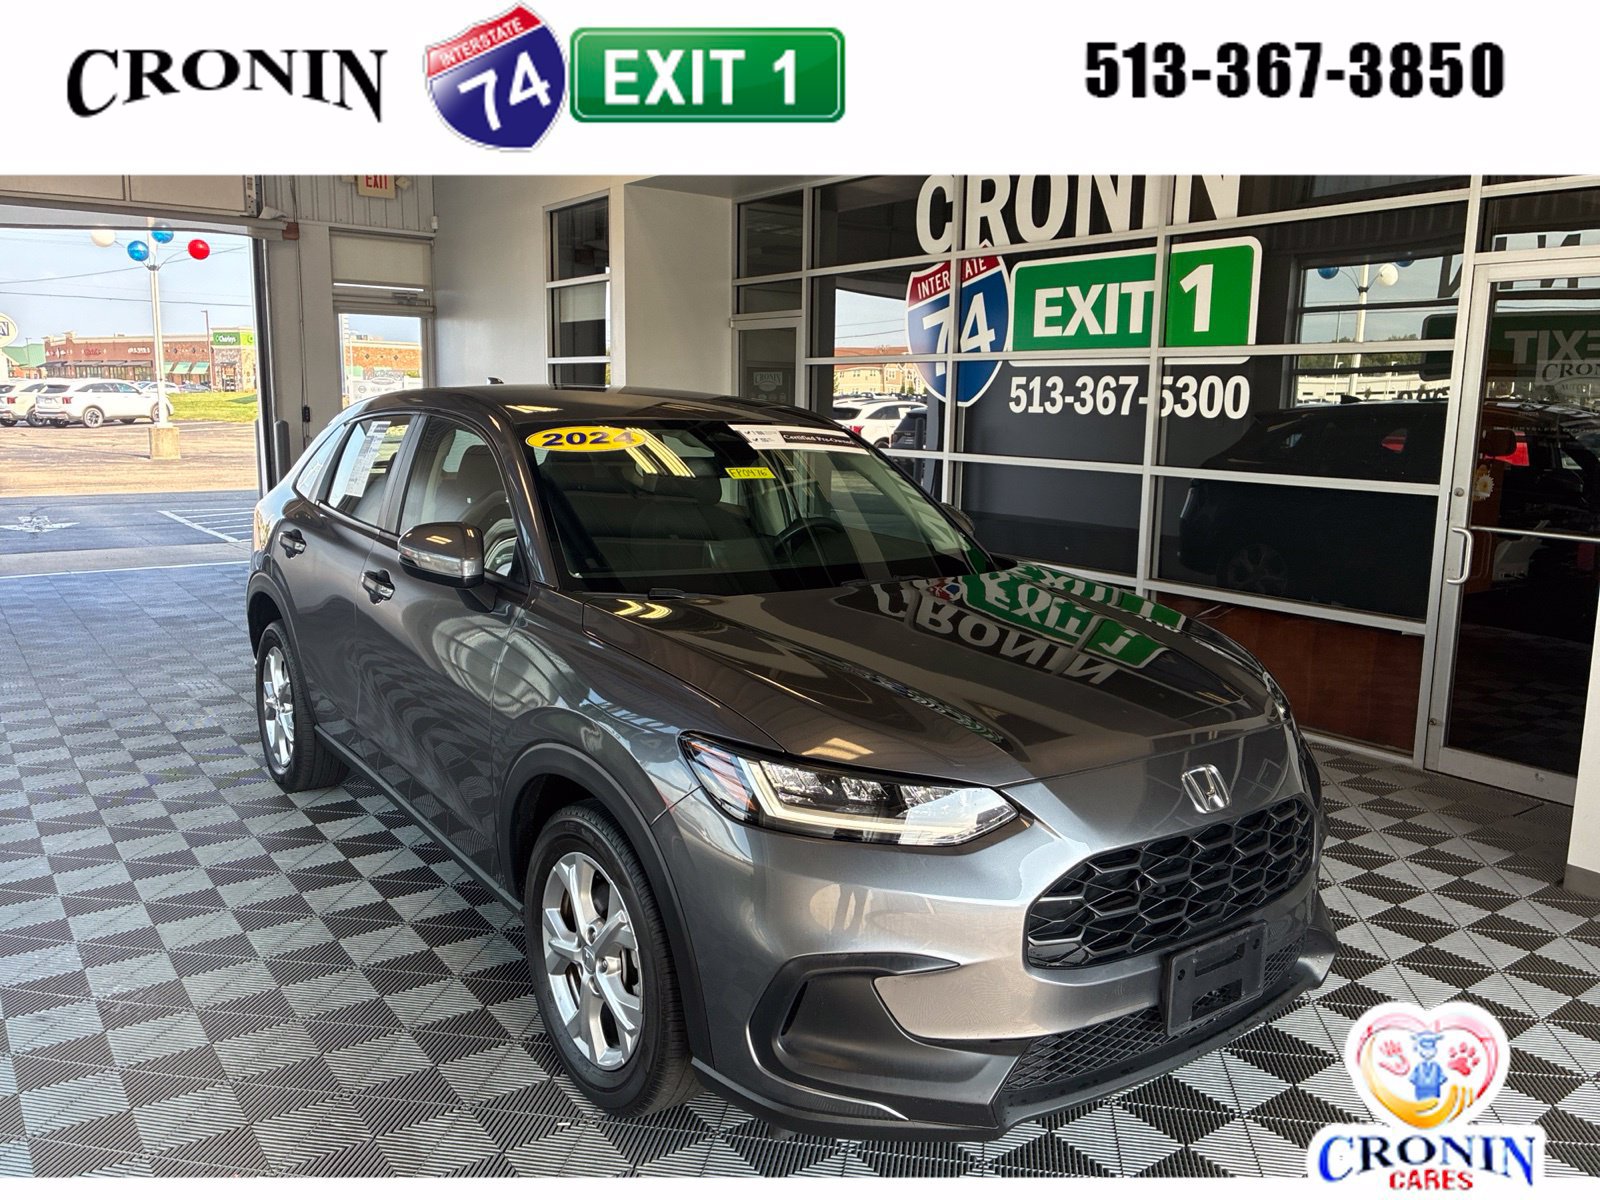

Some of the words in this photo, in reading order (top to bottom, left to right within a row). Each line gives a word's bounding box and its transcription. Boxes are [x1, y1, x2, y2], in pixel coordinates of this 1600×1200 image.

[916, 174, 1239, 254] CRONIN
[917, 258, 988, 300] INTERATE
[1034, 282, 1156, 338] EXIT
[1179, 264, 1214, 332] 1
[922, 292, 996, 376] 74
[542, 432, 634, 447] 2024
[783, 433, 816, 443] Certified
